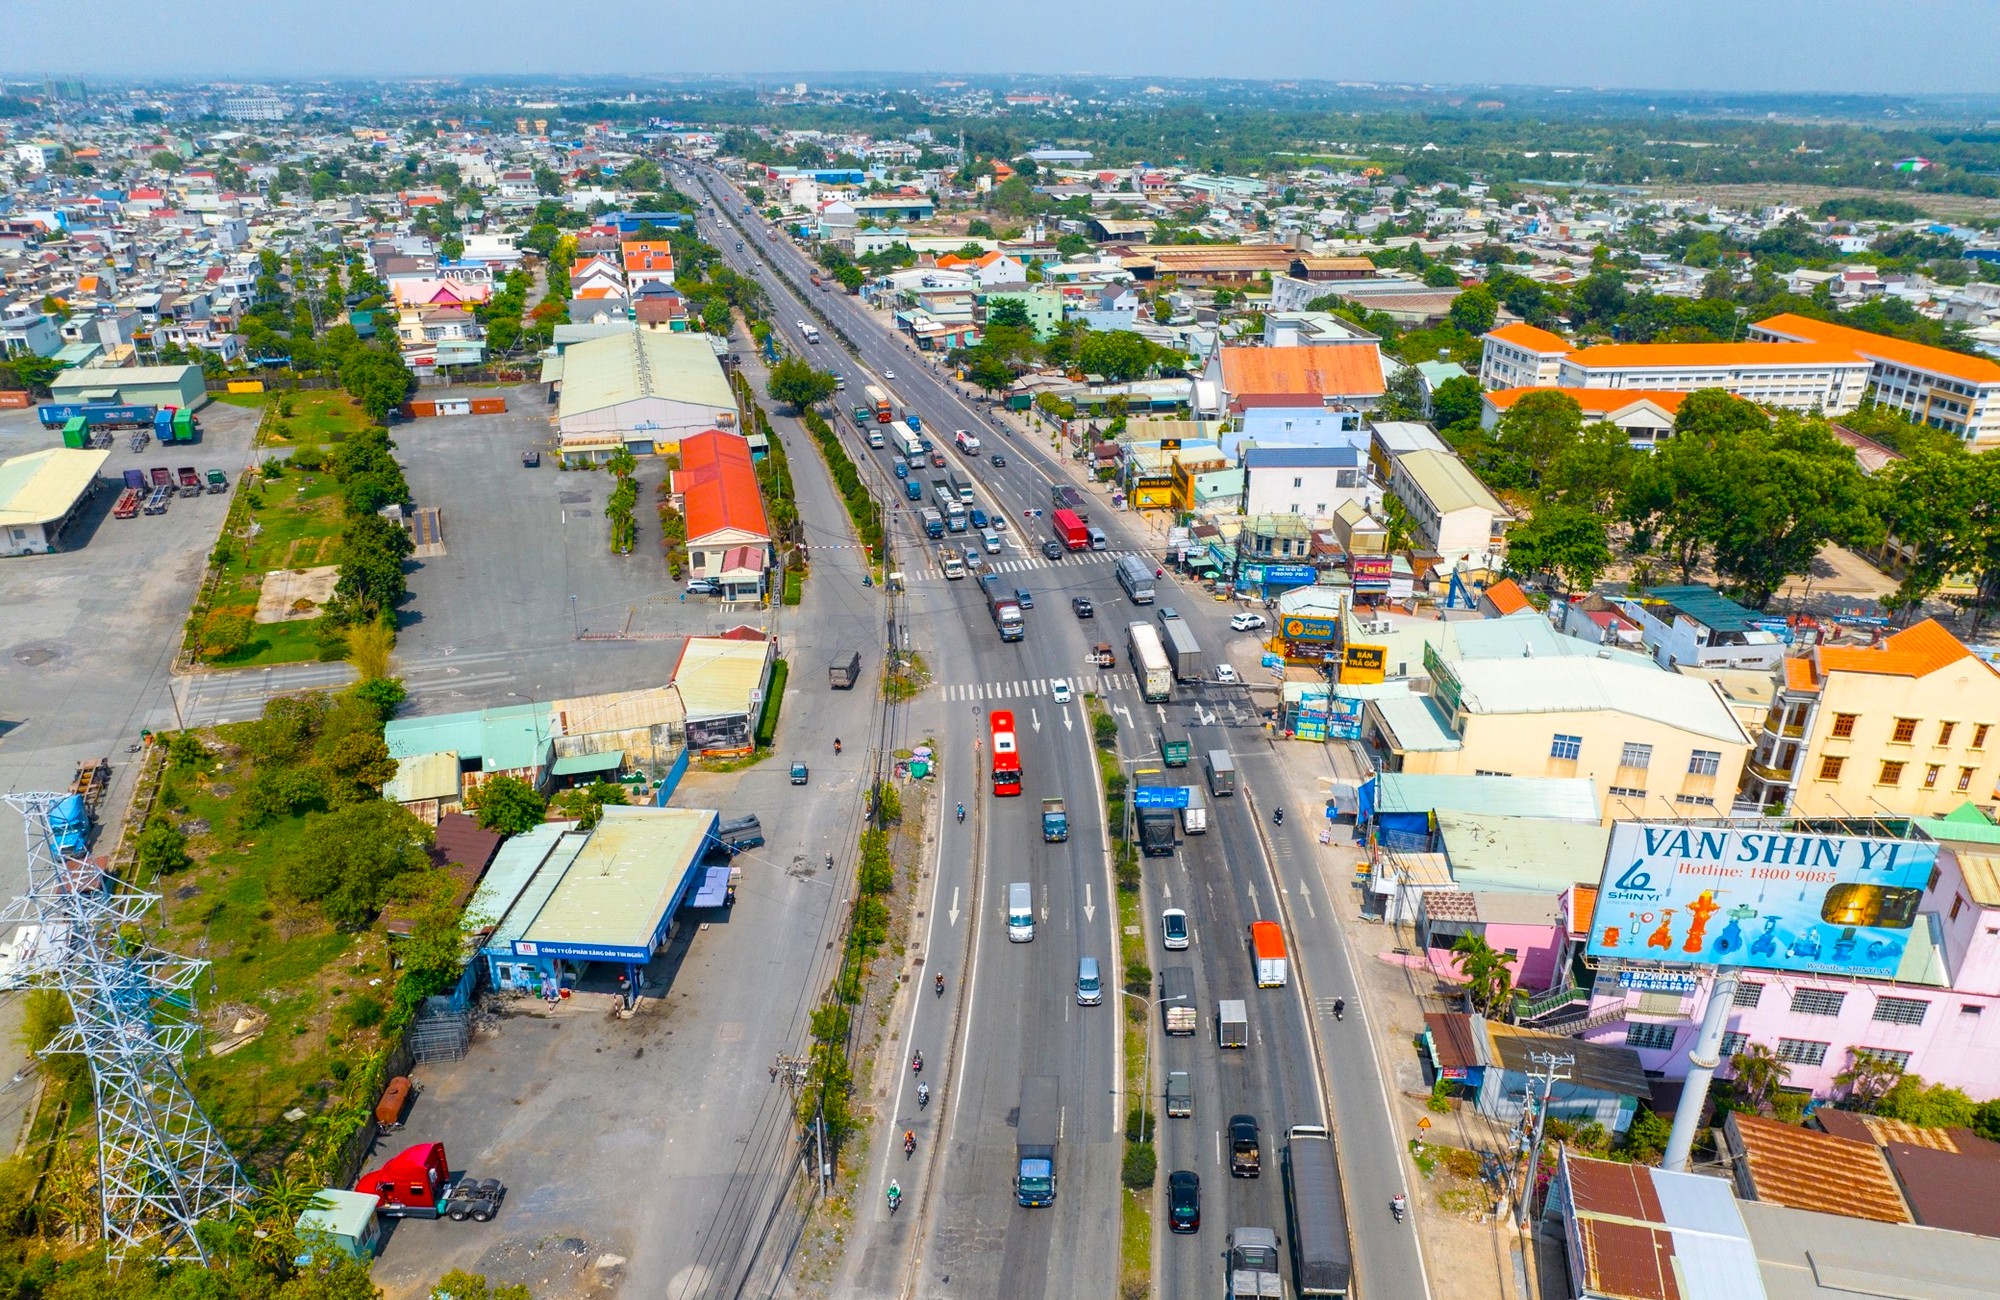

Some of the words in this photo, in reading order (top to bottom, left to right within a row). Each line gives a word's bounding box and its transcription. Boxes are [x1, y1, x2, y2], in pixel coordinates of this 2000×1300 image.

[1357, 651, 1373, 659] BÁN
[1350, 659, 1363, 667] TRẢ
[1364, 660, 1380, 668] GÓP
[1643, 827, 1729, 860] VAN
[1736, 833, 1847, 868] SHIN
[1859, 841, 1902, 872] YI
[1679, 863, 1744, 878] Hotline:
[1750, 867, 1790, 881] 1800
[1795, 870, 1838, 884] 9085
[1608, 892, 1644, 901] SHIN
[1632, 972, 1697, 983] BIZMAN.VN
